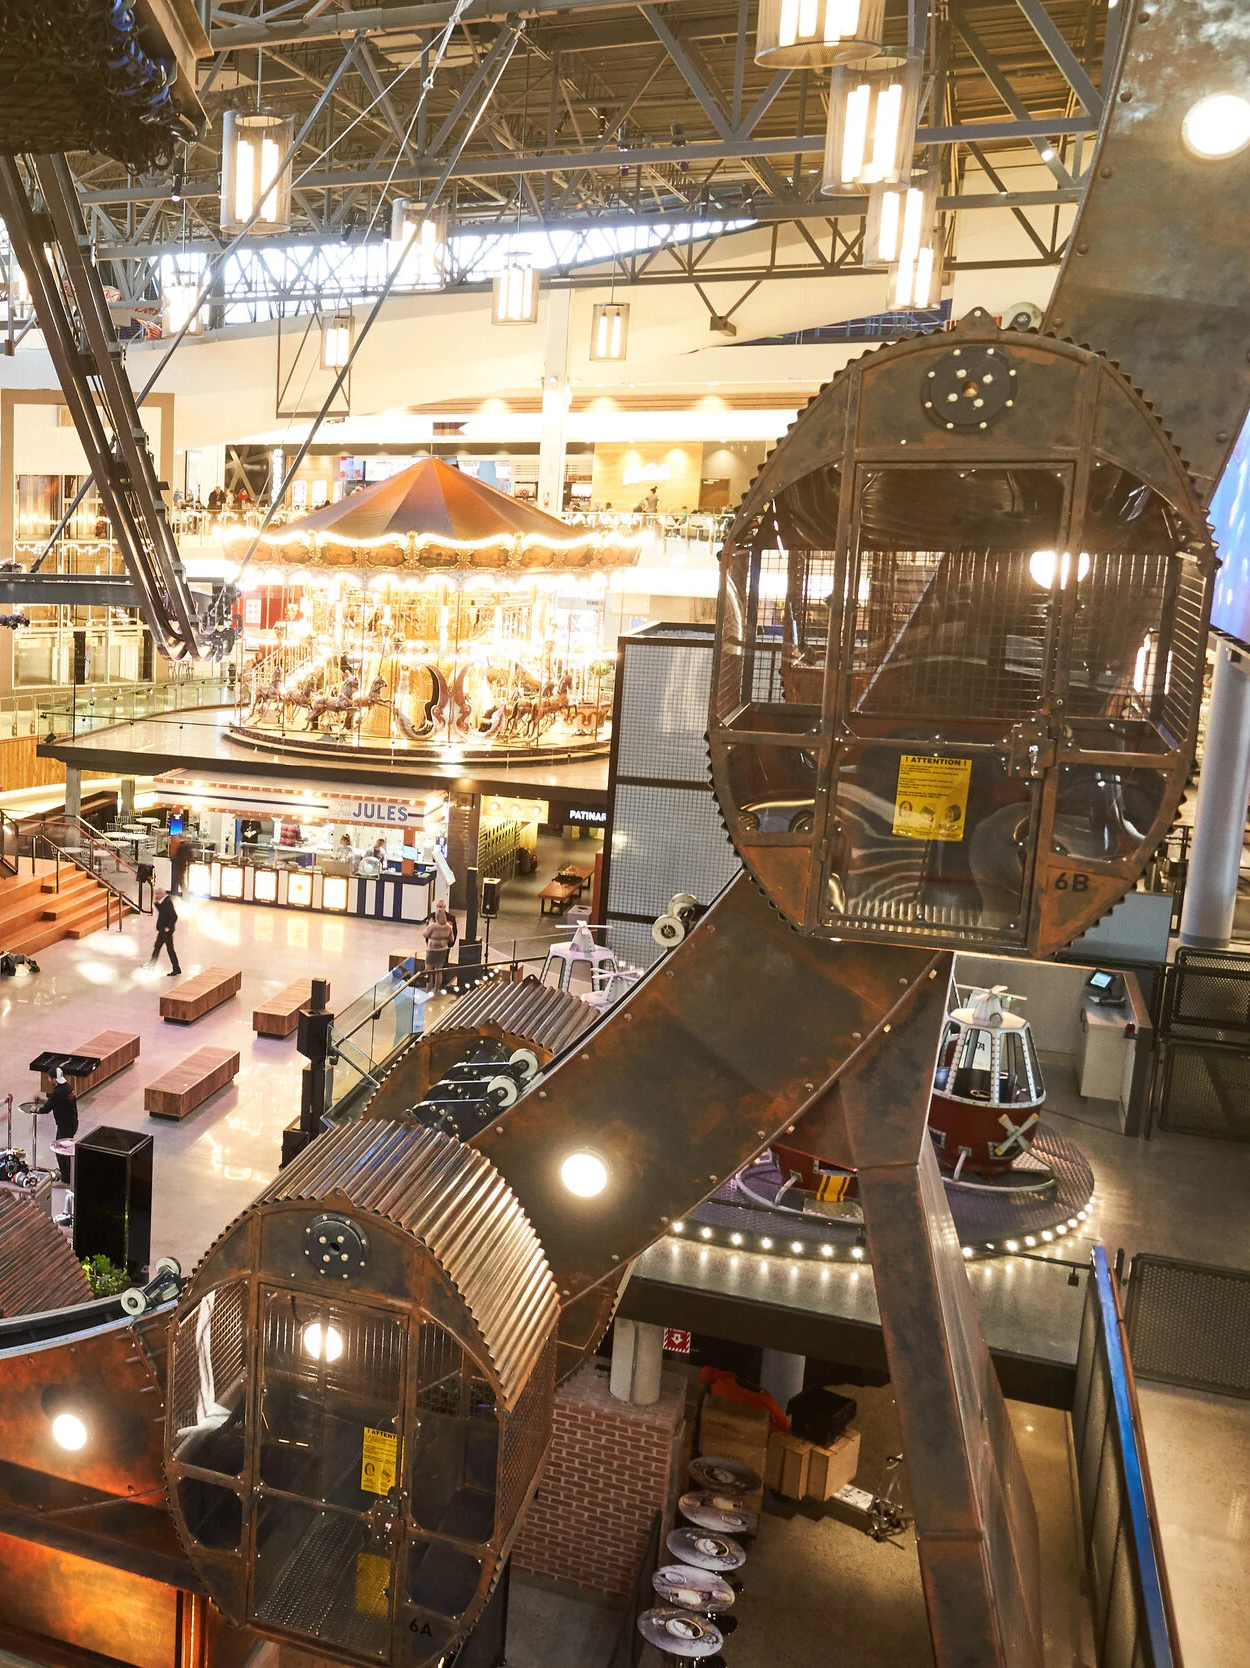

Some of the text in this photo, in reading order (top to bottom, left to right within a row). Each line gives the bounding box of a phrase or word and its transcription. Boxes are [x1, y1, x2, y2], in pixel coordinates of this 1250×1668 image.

[911, 757, 961, 766] ATTENTION
[352, 802, 408, 822] JULES
[1055, 872, 1089, 892] 6B
[409, 1618, 432, 1637] 6A
